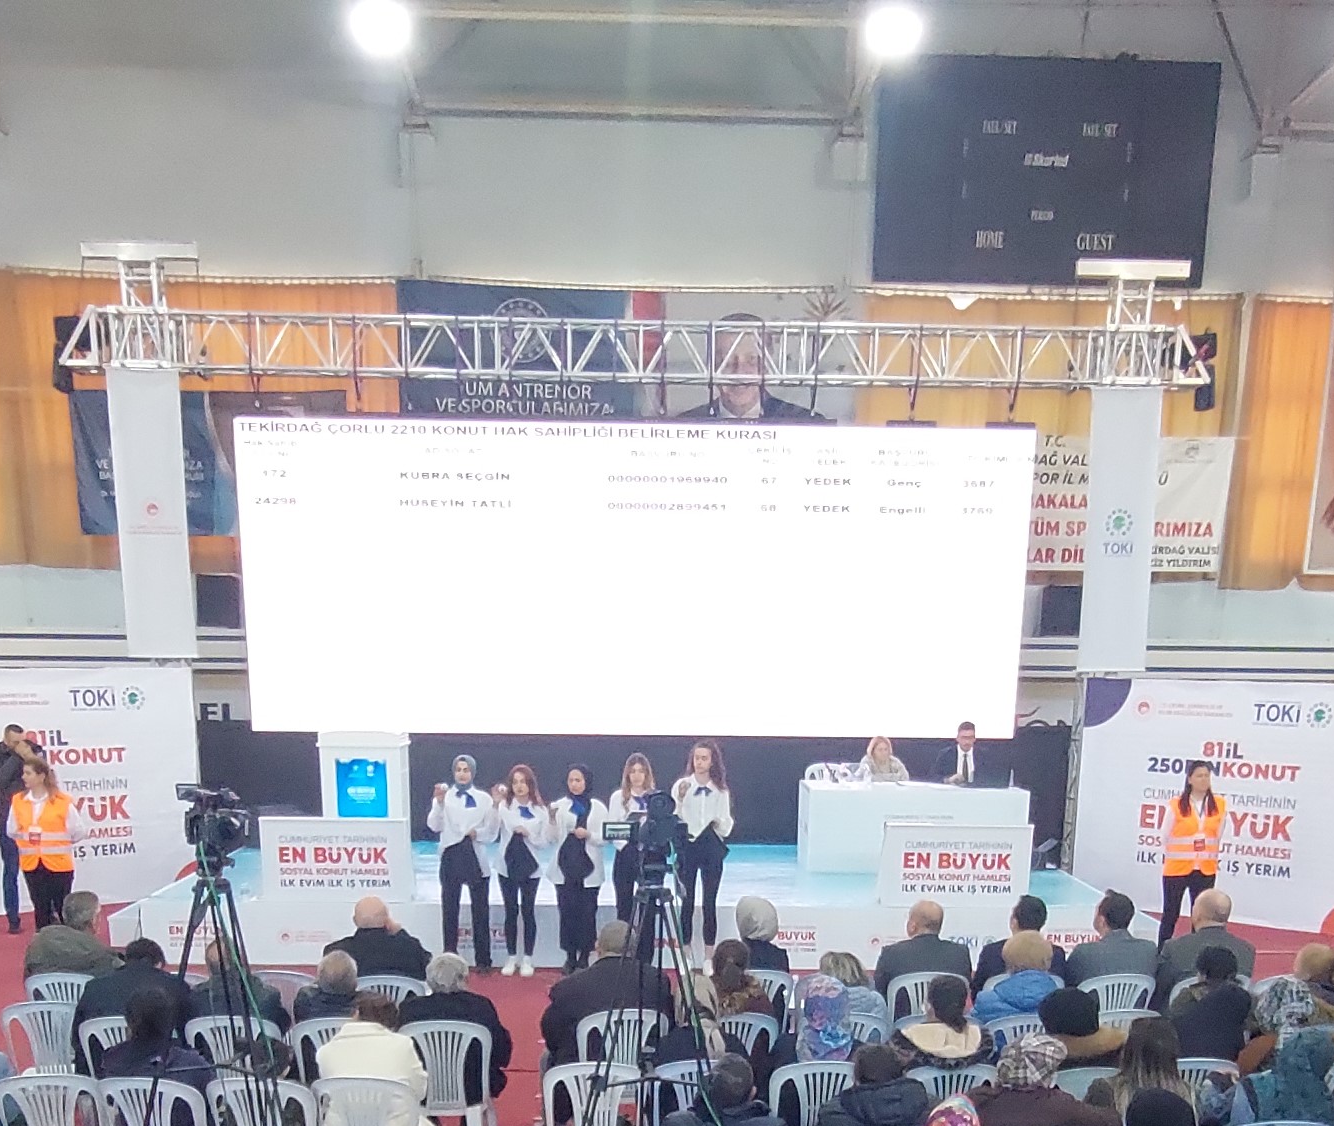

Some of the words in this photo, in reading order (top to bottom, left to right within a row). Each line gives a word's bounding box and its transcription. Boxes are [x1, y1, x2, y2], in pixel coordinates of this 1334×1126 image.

[975, 230, 1004, 249] HOME
[1076, 233, 1115, 251] GUEST
[239, 421, 322, 434] TEKİRDAĞ
[328, 423, 385, 436] ÇORLU
[391, 425, 426, 435] 2210
[432, 425, 488, 436] KONUT
[618, 426, 710, 440] BELİRLEME
[716, 429, 777, 440] KURASI
[1045, 434, 1066, 448] T.C.
[804, 477, 851, 486] YEDEK
[887, 479, 922, 488] Genç
[803, 505, 851, 513] YEDEK
[63, 776, 128, 793] TARİHİNİN
[1230, 793, 1297, 810] TARİHİNİN
[88, 825, 133, 840] AMLESİ
[1229, 811, 1294, 842] YÜK
[91, 842, 136, 858] YERİM
[278, 846, 306, 863] EN
[314, 847, 388, 865] BÜYÜK
[1235, 844, 1291, 860] HAMLESİ
[903, 852, 931, 869] EN
[938, 853, 1011, 871] BÜYÜK
[1245, 862, 1291, 878] YERİM
[359, 879, 391, 888] YERİM
[980, 885, 1011, 894] YERİM
